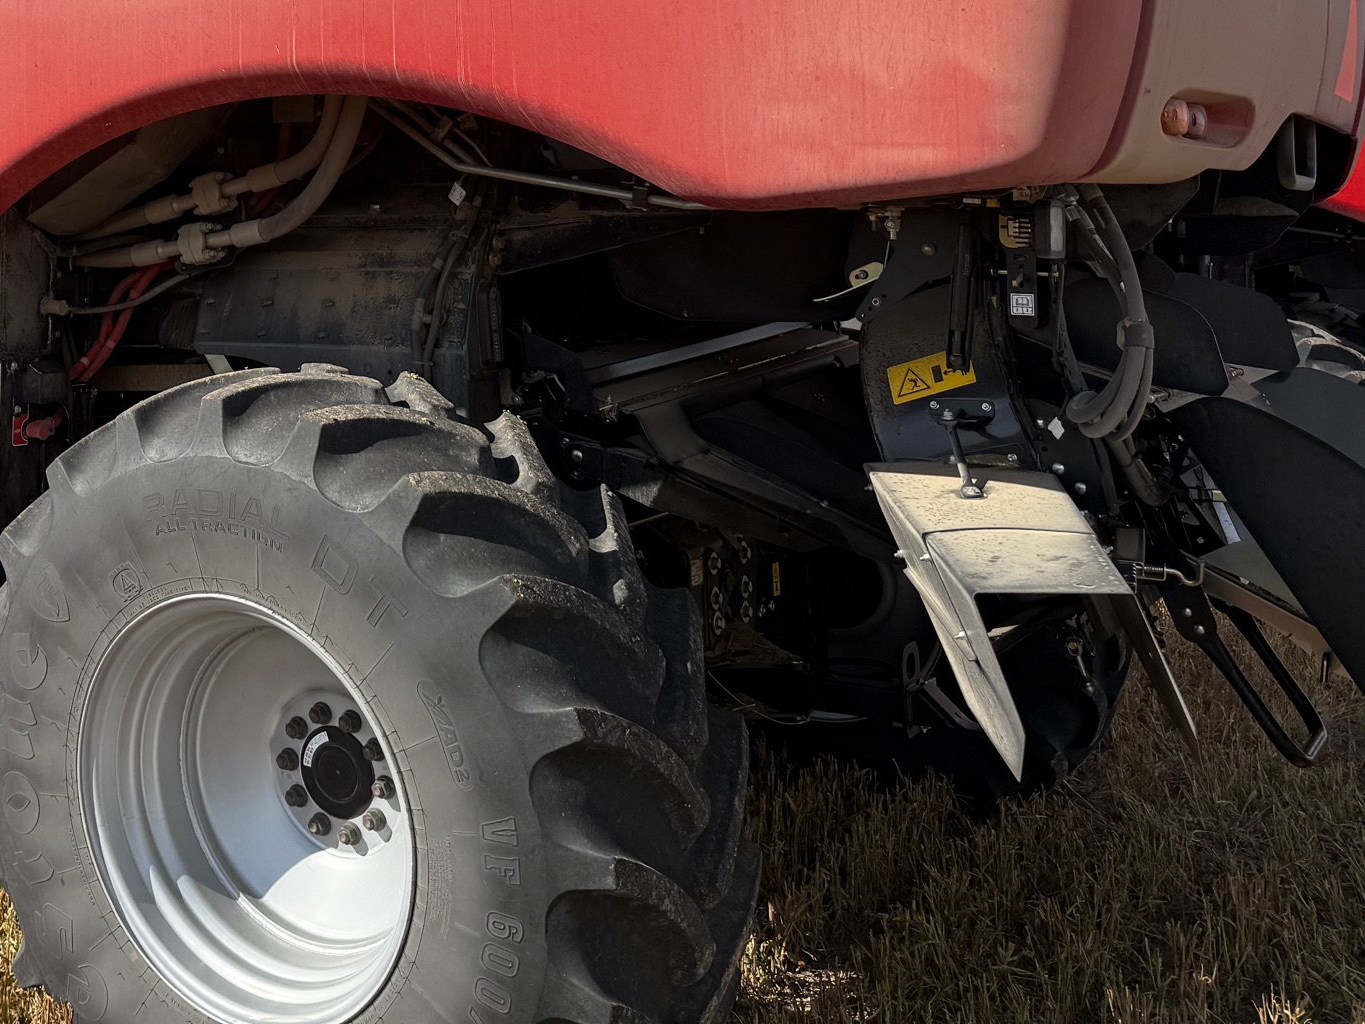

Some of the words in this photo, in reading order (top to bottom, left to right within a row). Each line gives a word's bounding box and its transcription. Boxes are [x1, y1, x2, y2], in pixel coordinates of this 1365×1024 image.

[141, 487, 291, 543] RADIAL
[155, 517, 187, 536] ALL
[191, 518, 284, 553] TRACTION
[481, 815, 522, 887] VF
